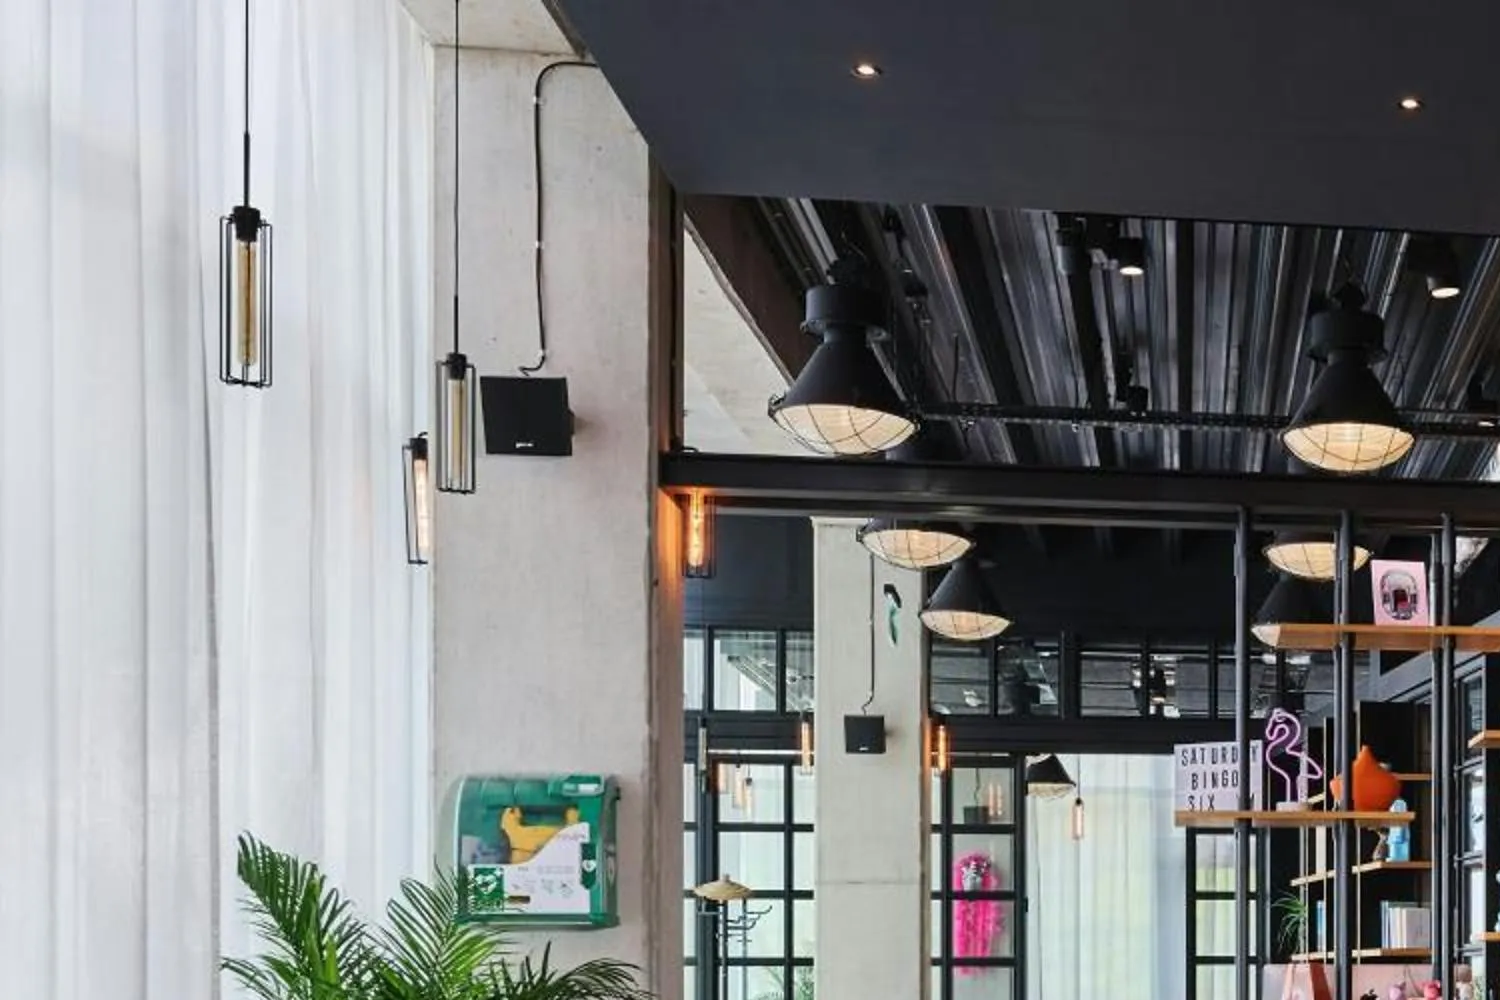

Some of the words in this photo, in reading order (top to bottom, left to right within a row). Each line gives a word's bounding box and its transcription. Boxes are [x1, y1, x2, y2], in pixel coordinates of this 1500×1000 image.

[1181, 745, 1259, 767] SATURDY
[1191, 769, 1239, 791] BINGO
[1187, 793, 1216, 812] SIX
